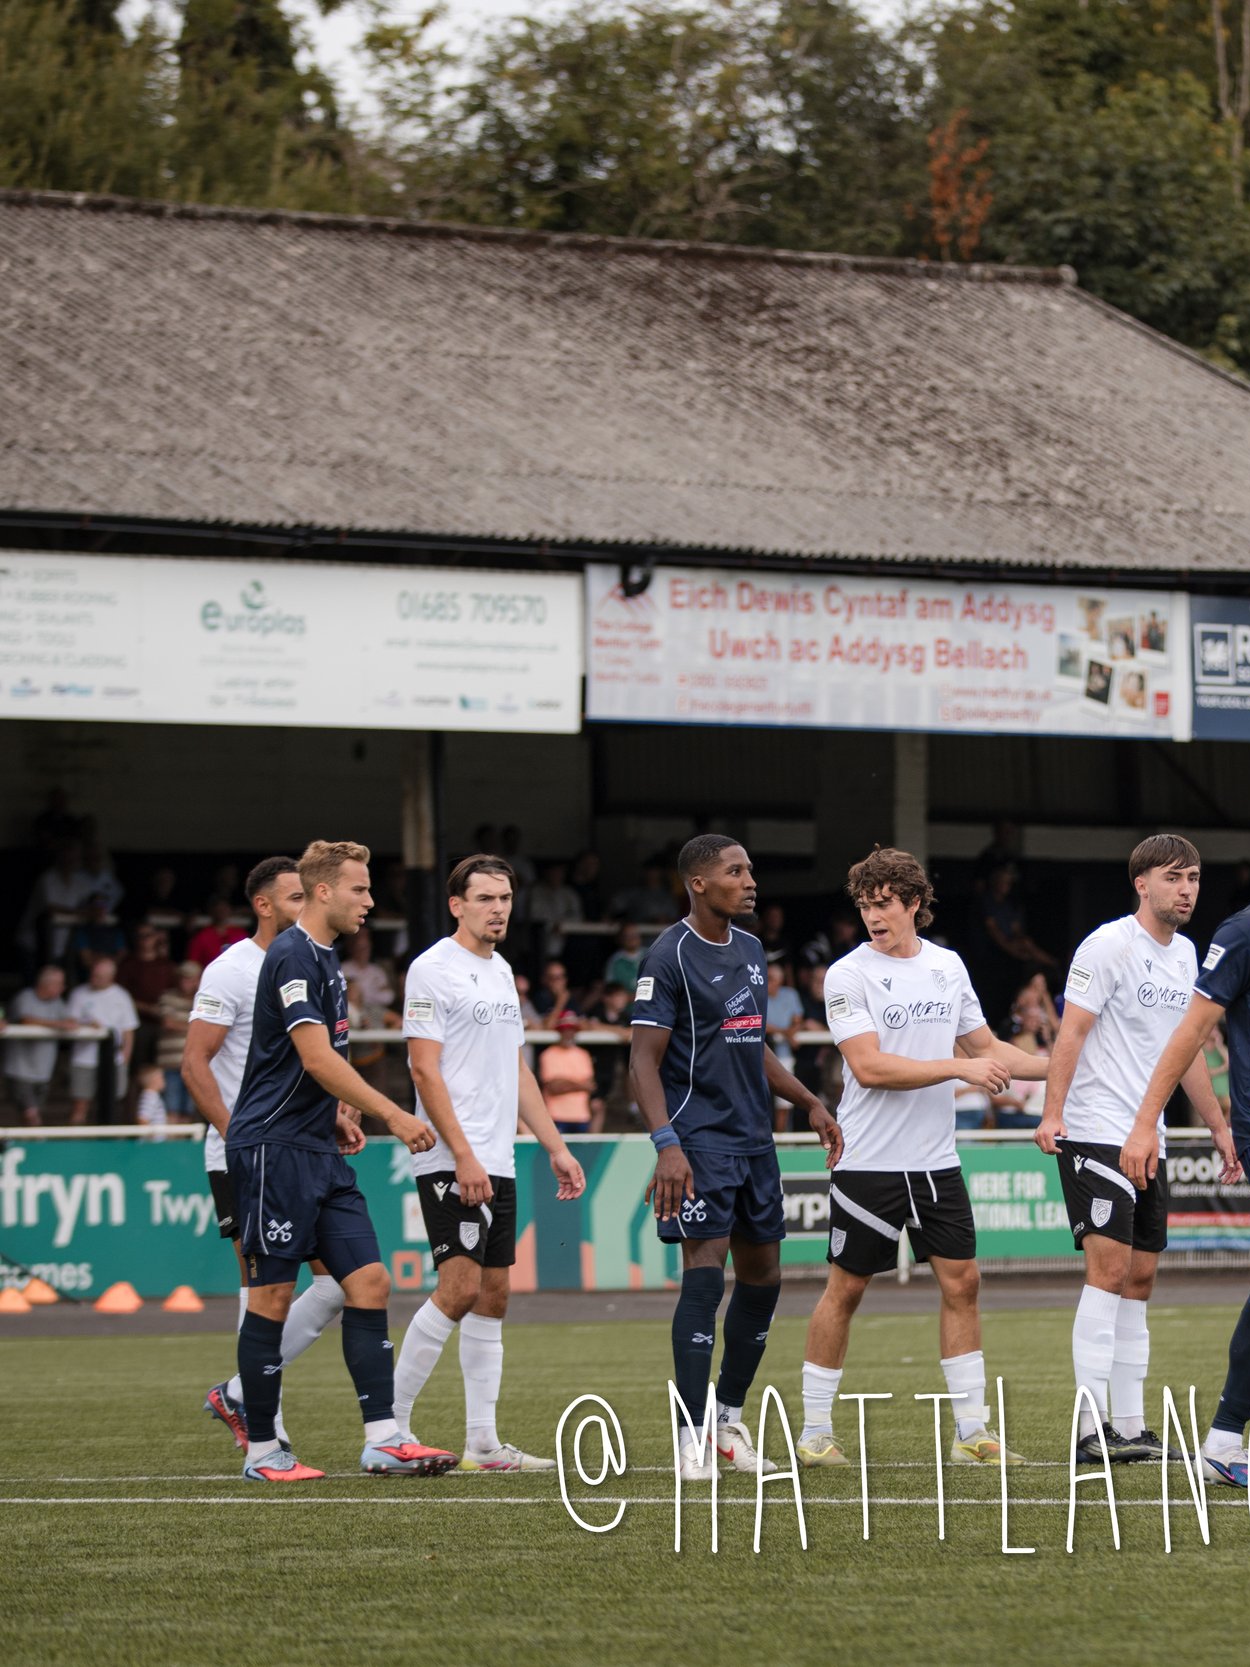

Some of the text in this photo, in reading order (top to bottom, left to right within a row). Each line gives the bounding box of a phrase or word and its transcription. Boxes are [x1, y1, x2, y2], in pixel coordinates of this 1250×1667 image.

[397, 589, 548, 625] 01685 709570
[670, 578, 1056, 633] Eich Dewis Cyntaf am Addysg
[709, 628, 1028, 674] Uwch ac Addysg Bellach
[724, 1018, 749, 1028] Designer
[725, 1036, 742, 1044] West
[1013, 1171, 1047, 1201] FOR
[143, 1179, 220, 1237] Twy
